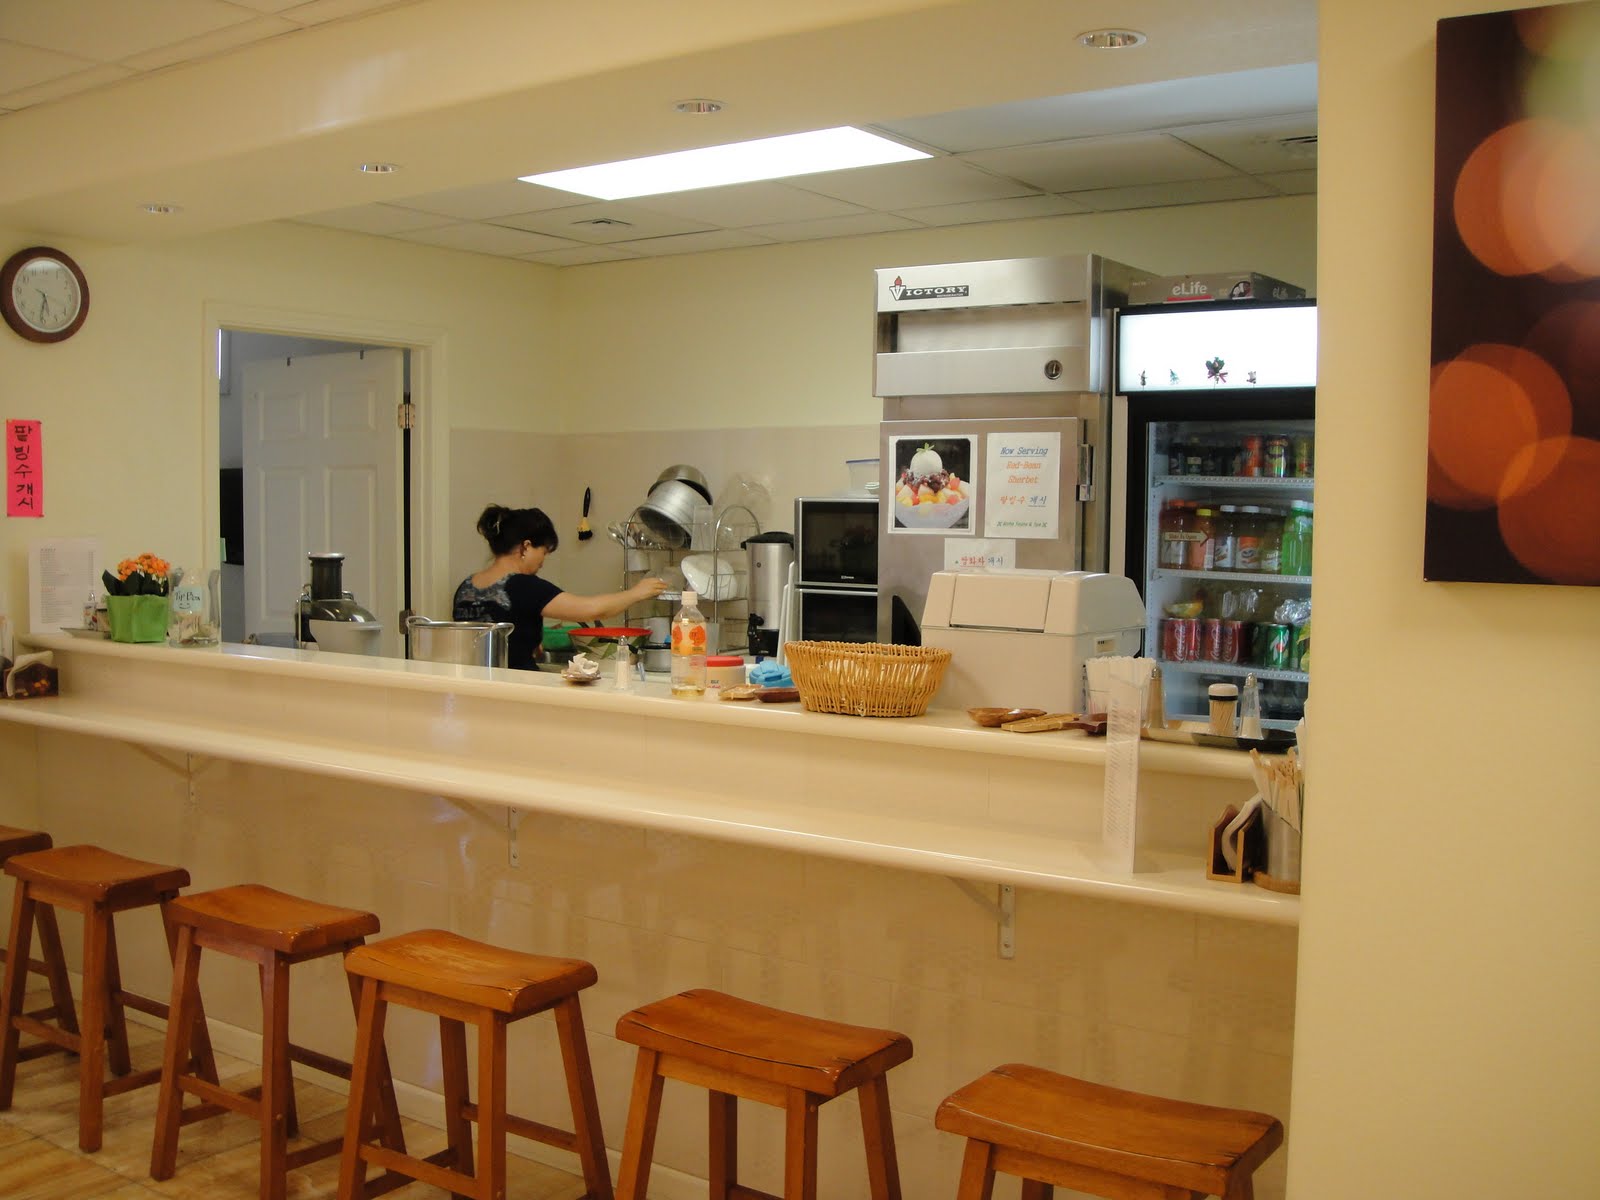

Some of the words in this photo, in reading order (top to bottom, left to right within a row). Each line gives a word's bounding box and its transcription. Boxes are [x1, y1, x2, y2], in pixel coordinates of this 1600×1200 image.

[889, 285, 967, 301] VICTORY
[1172, 281, 1208, 297] eLife
[1000, 446, 1015, 456] Now
[1017, 446, 1049, 457] Serving
